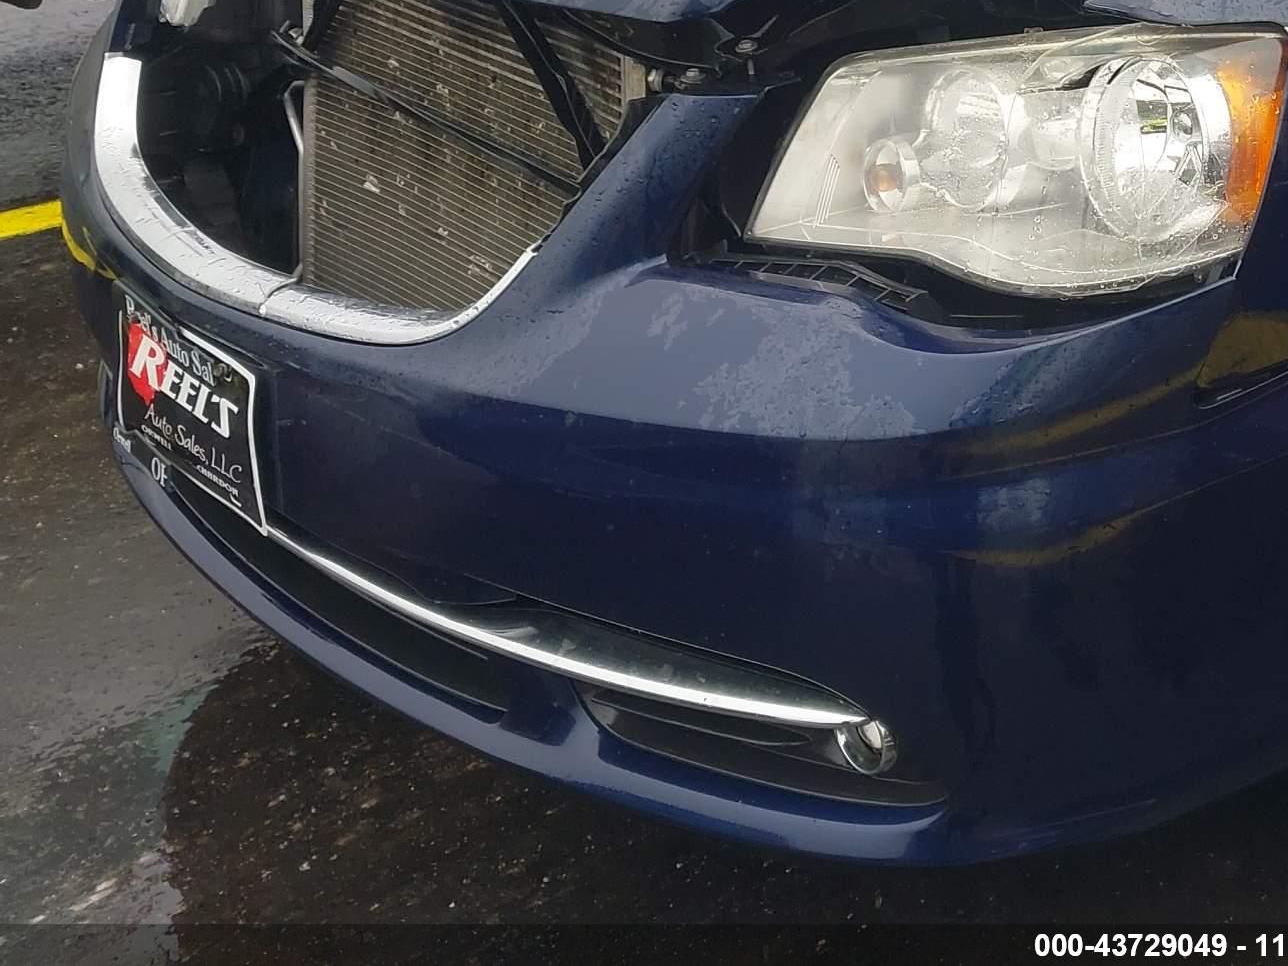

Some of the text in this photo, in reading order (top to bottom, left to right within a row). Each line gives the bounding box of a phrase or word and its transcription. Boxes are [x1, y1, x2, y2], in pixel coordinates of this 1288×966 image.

[129, 333, 239, 439] REEL'S
[160, 327, 190, 368] Auto
[144, 403, 243, 484] Auto Sales, LLC
